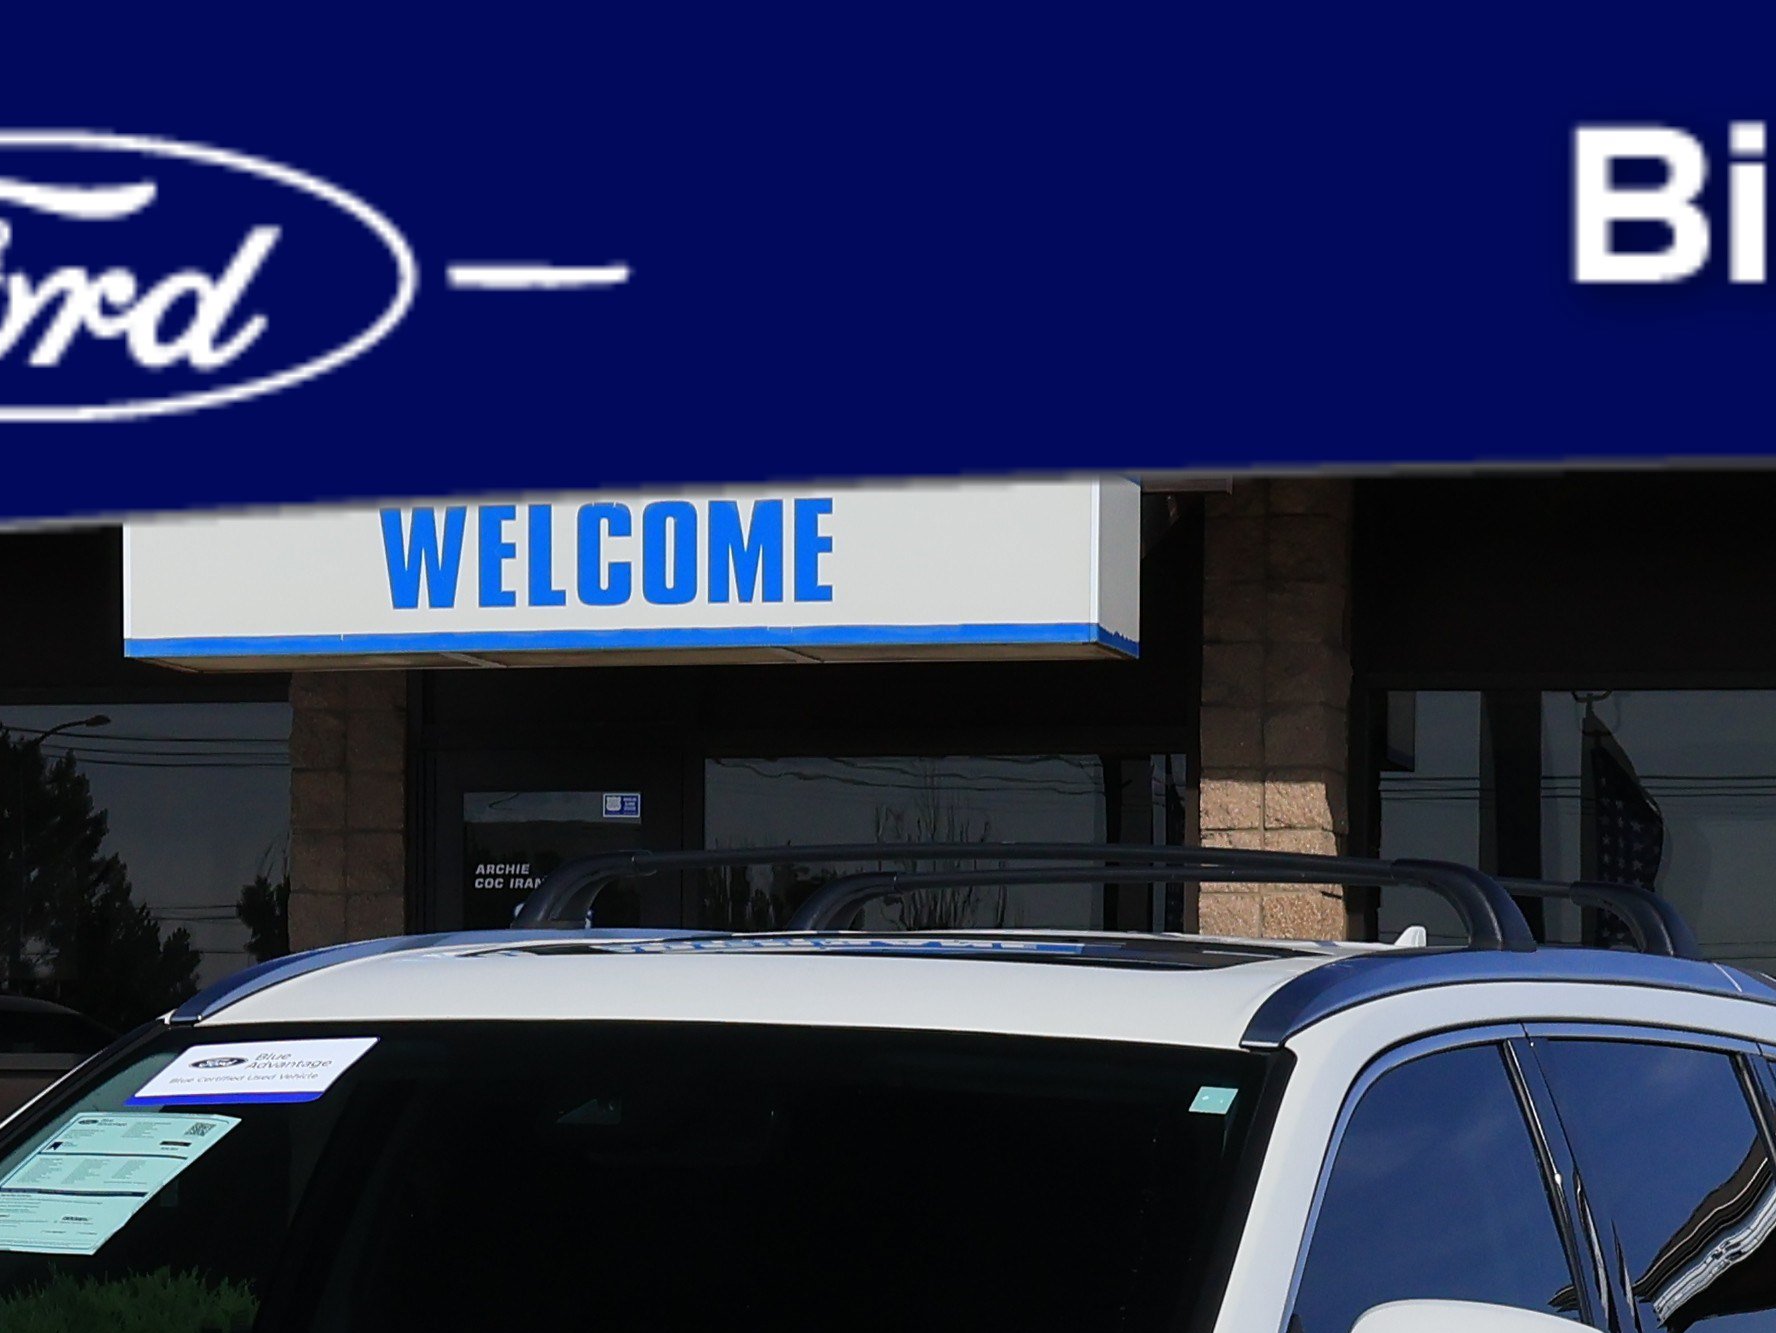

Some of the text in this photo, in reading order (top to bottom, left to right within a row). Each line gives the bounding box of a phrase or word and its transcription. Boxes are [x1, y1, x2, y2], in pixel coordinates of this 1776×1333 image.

[379, 498, 833, 609] WELCOME
[475, 864, 530, 875] ARCHIE
[245, 1060, 333, 1070] Advantage
